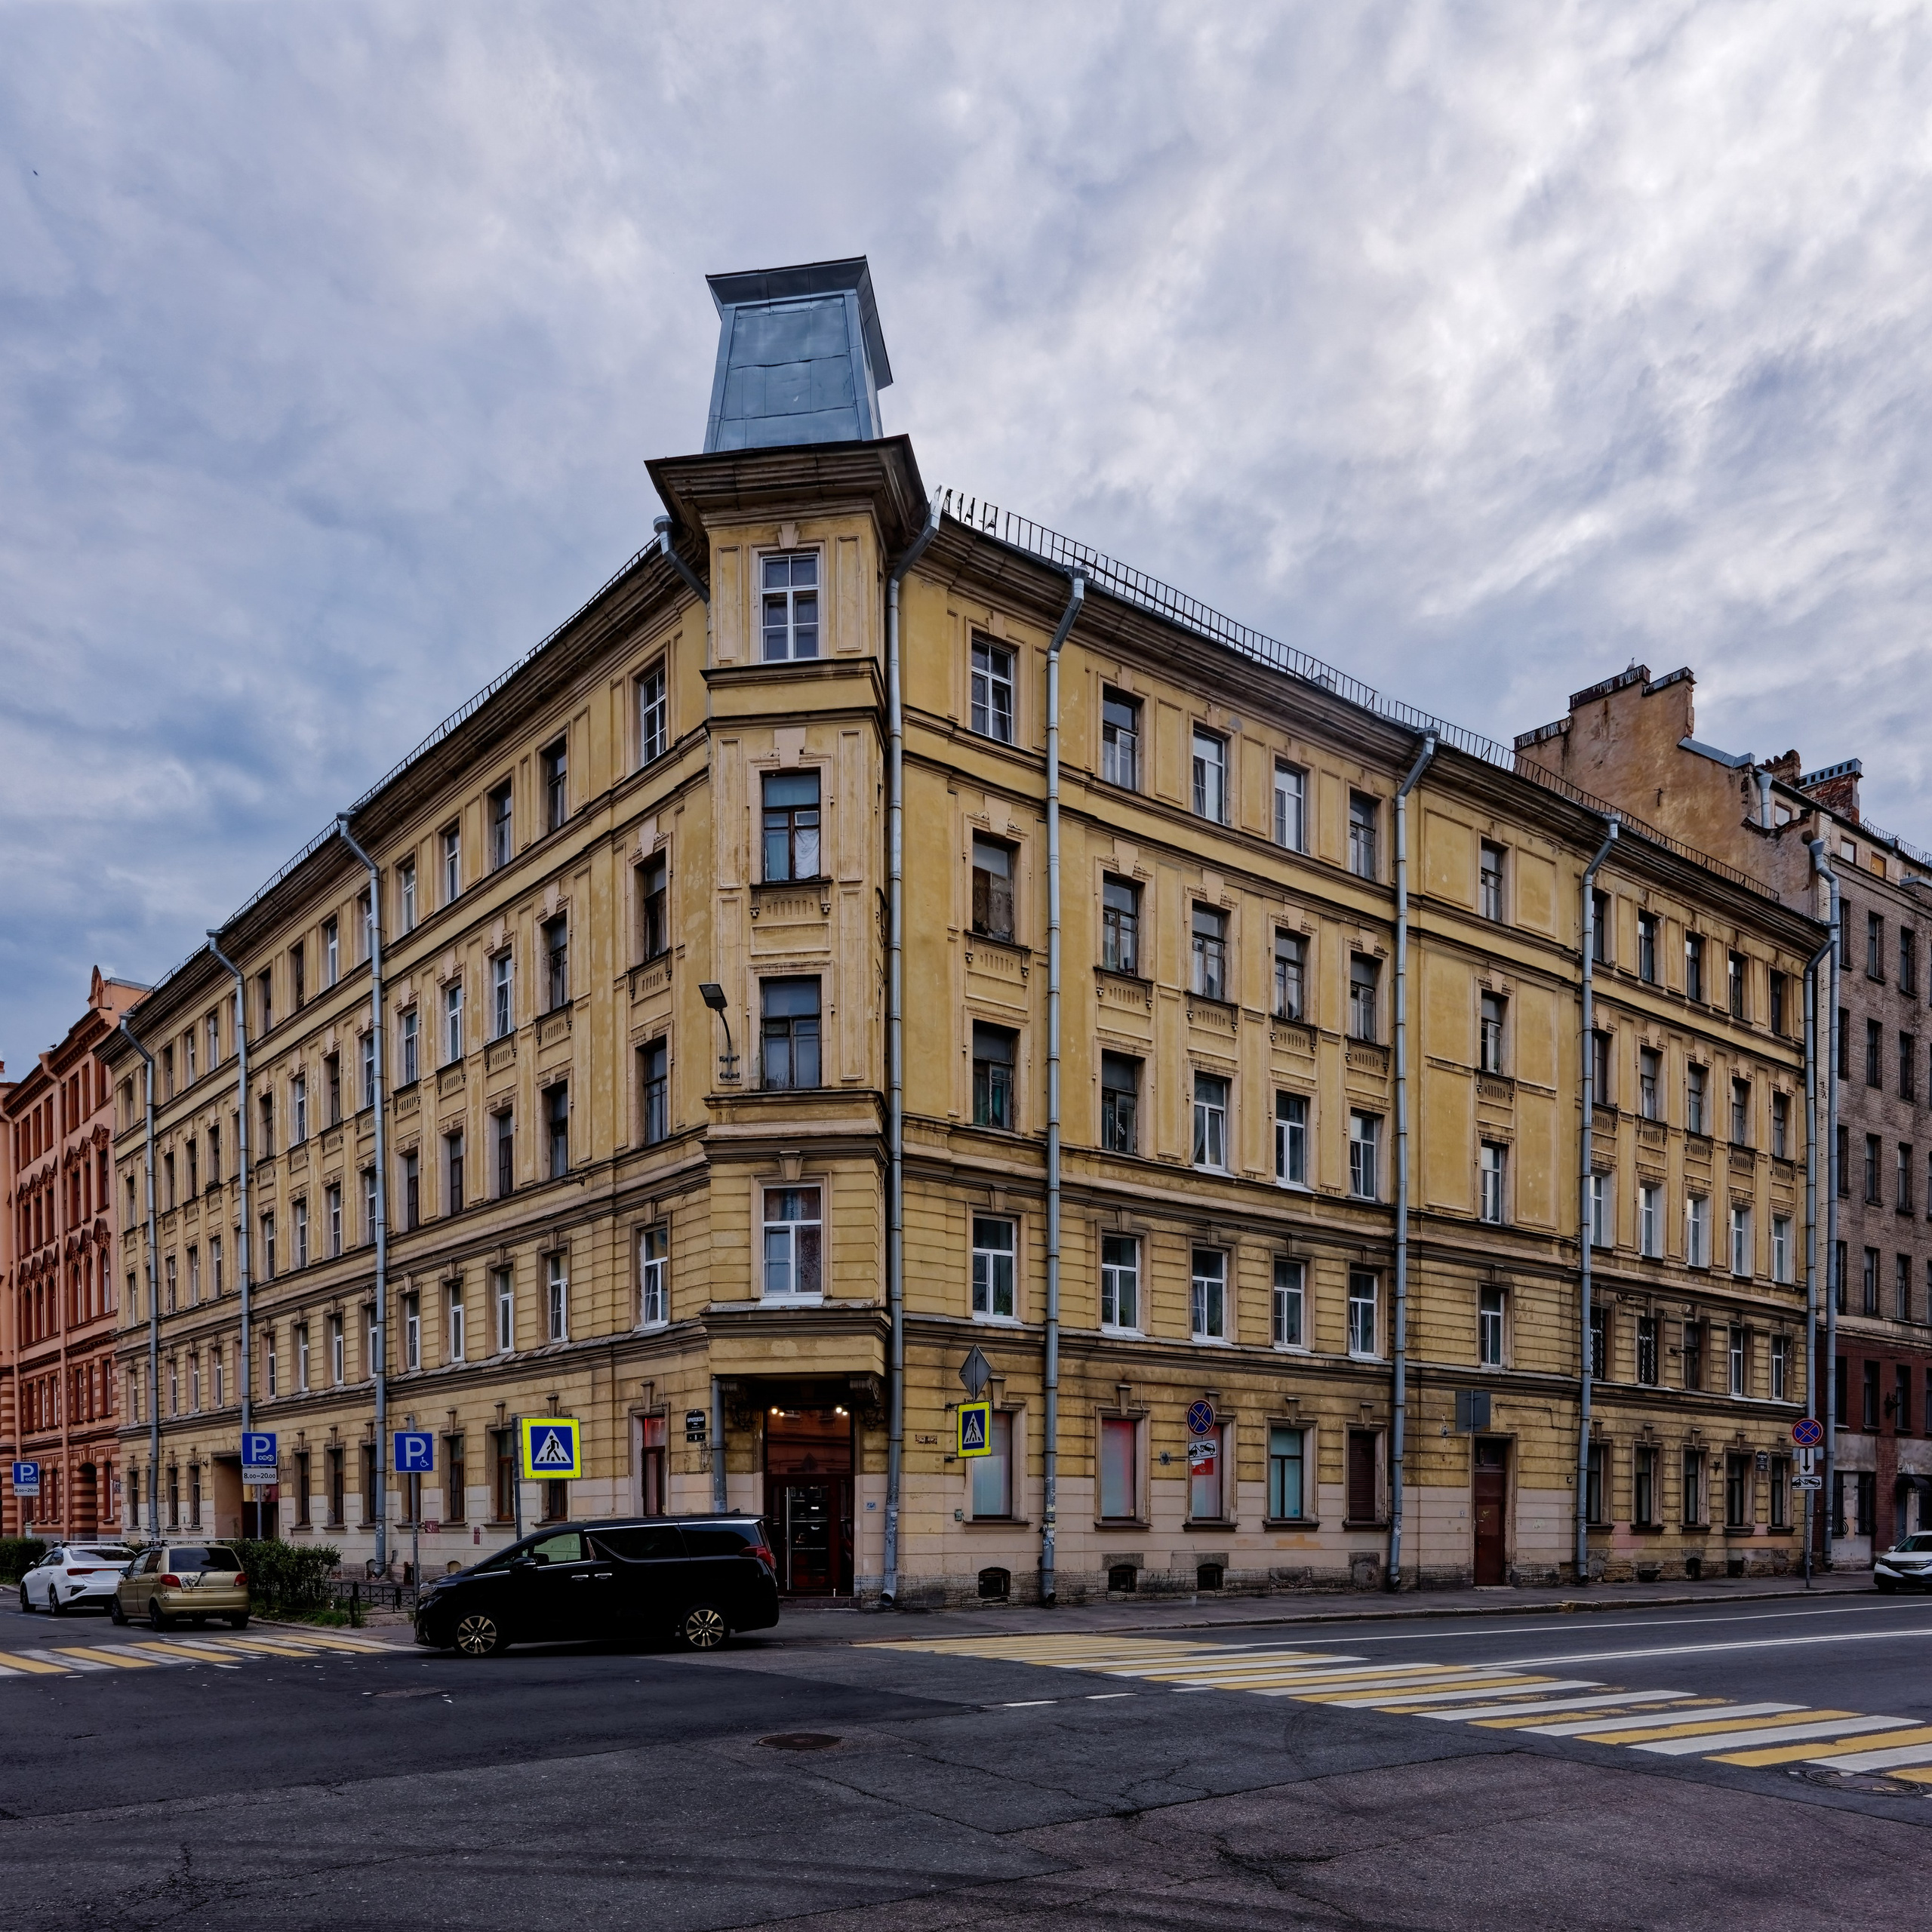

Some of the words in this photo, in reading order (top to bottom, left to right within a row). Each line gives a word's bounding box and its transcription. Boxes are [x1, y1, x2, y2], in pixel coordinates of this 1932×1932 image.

[251, 1436, 271, 1462] P
[405, 1437, 426, 1467] P
[20, 1464, 35, 1482] P
